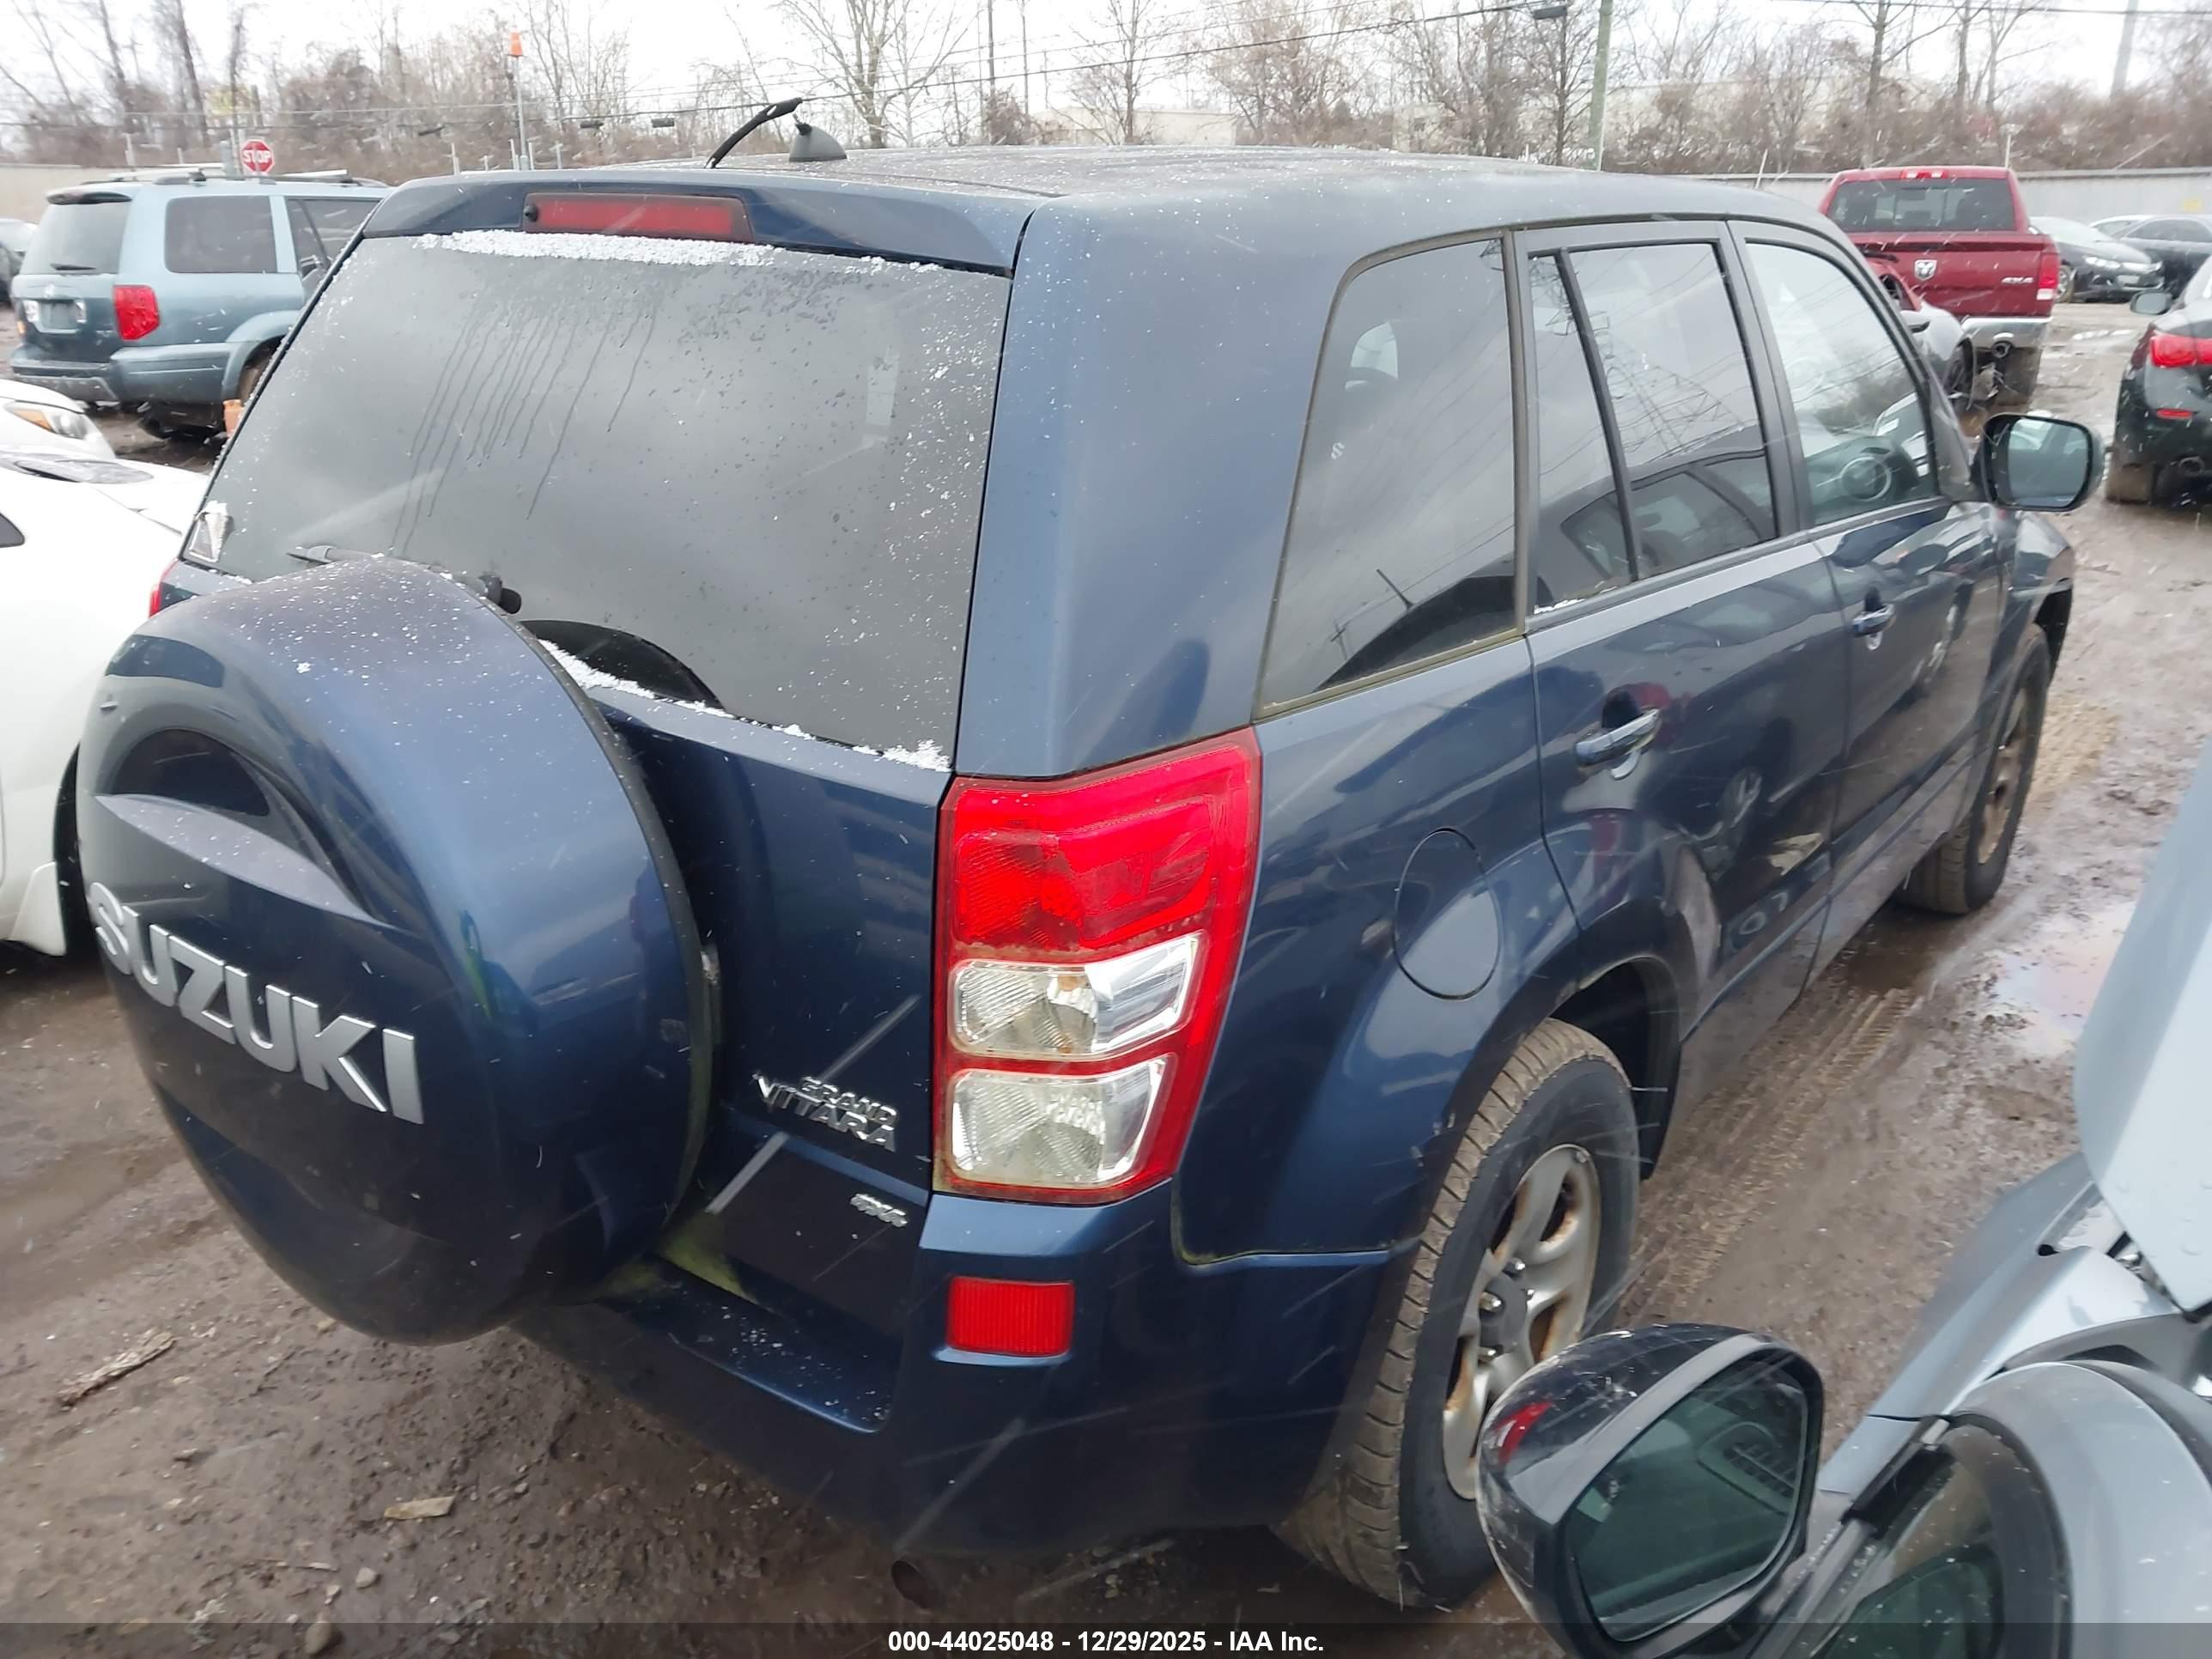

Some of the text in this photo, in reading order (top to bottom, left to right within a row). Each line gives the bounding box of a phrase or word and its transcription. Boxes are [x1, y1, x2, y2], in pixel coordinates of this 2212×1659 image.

[242, 149, 271, 164] STOP
[87, 882, 423, 1125] SUZUKI
[751, 1073, 896, 1152] VITARA
[800, 1076, 897, 1125] GRAND
